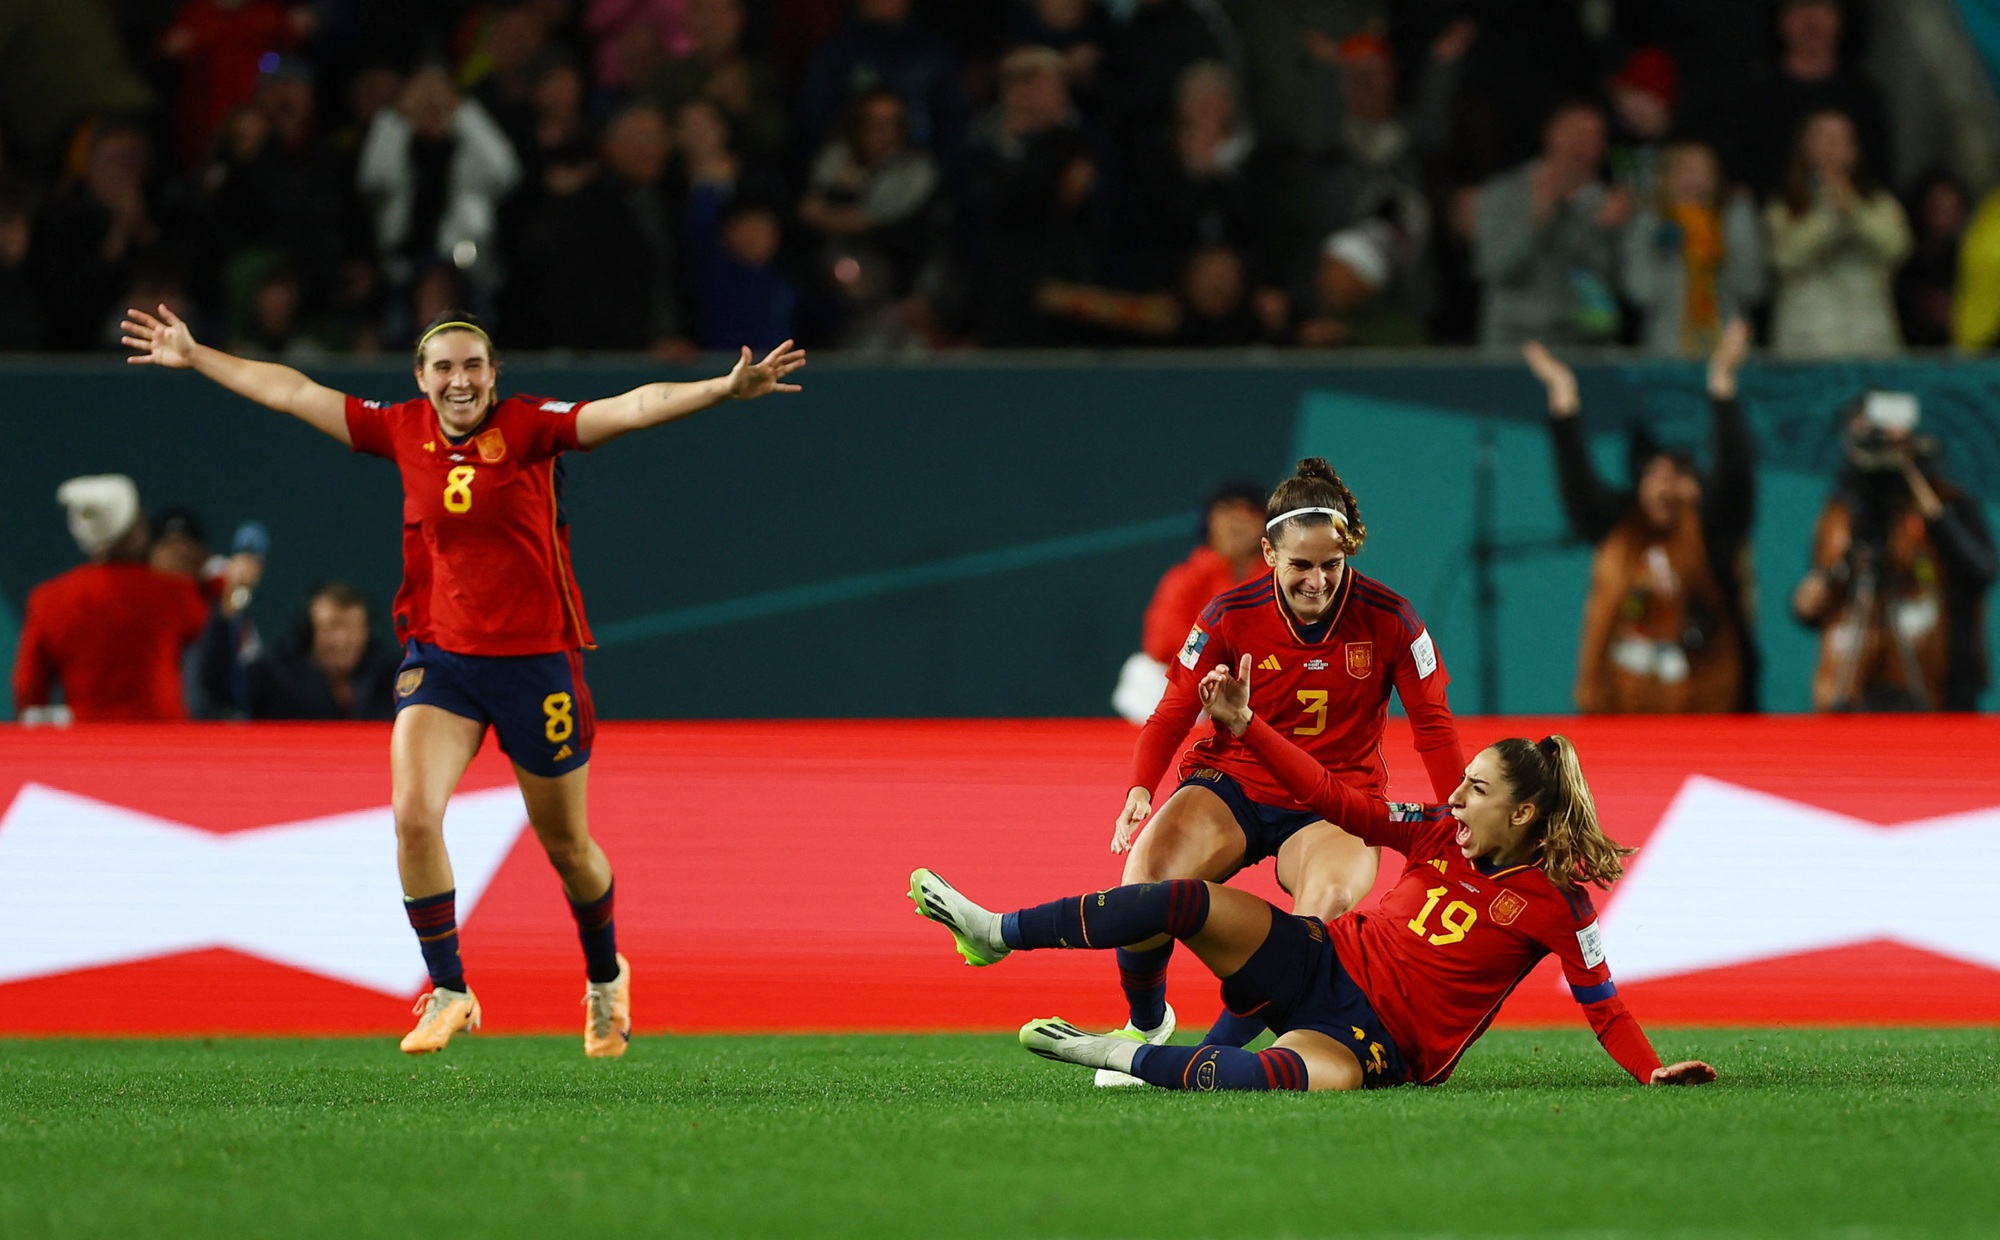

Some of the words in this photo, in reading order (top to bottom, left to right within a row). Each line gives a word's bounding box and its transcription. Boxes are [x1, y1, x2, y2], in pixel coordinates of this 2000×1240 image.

[443, 465, 476, 514] 8
[542, 691, 573, 744] 8
[1293, 689, 1329, 736] 3
[1407, 885, 1478, 946] 19
